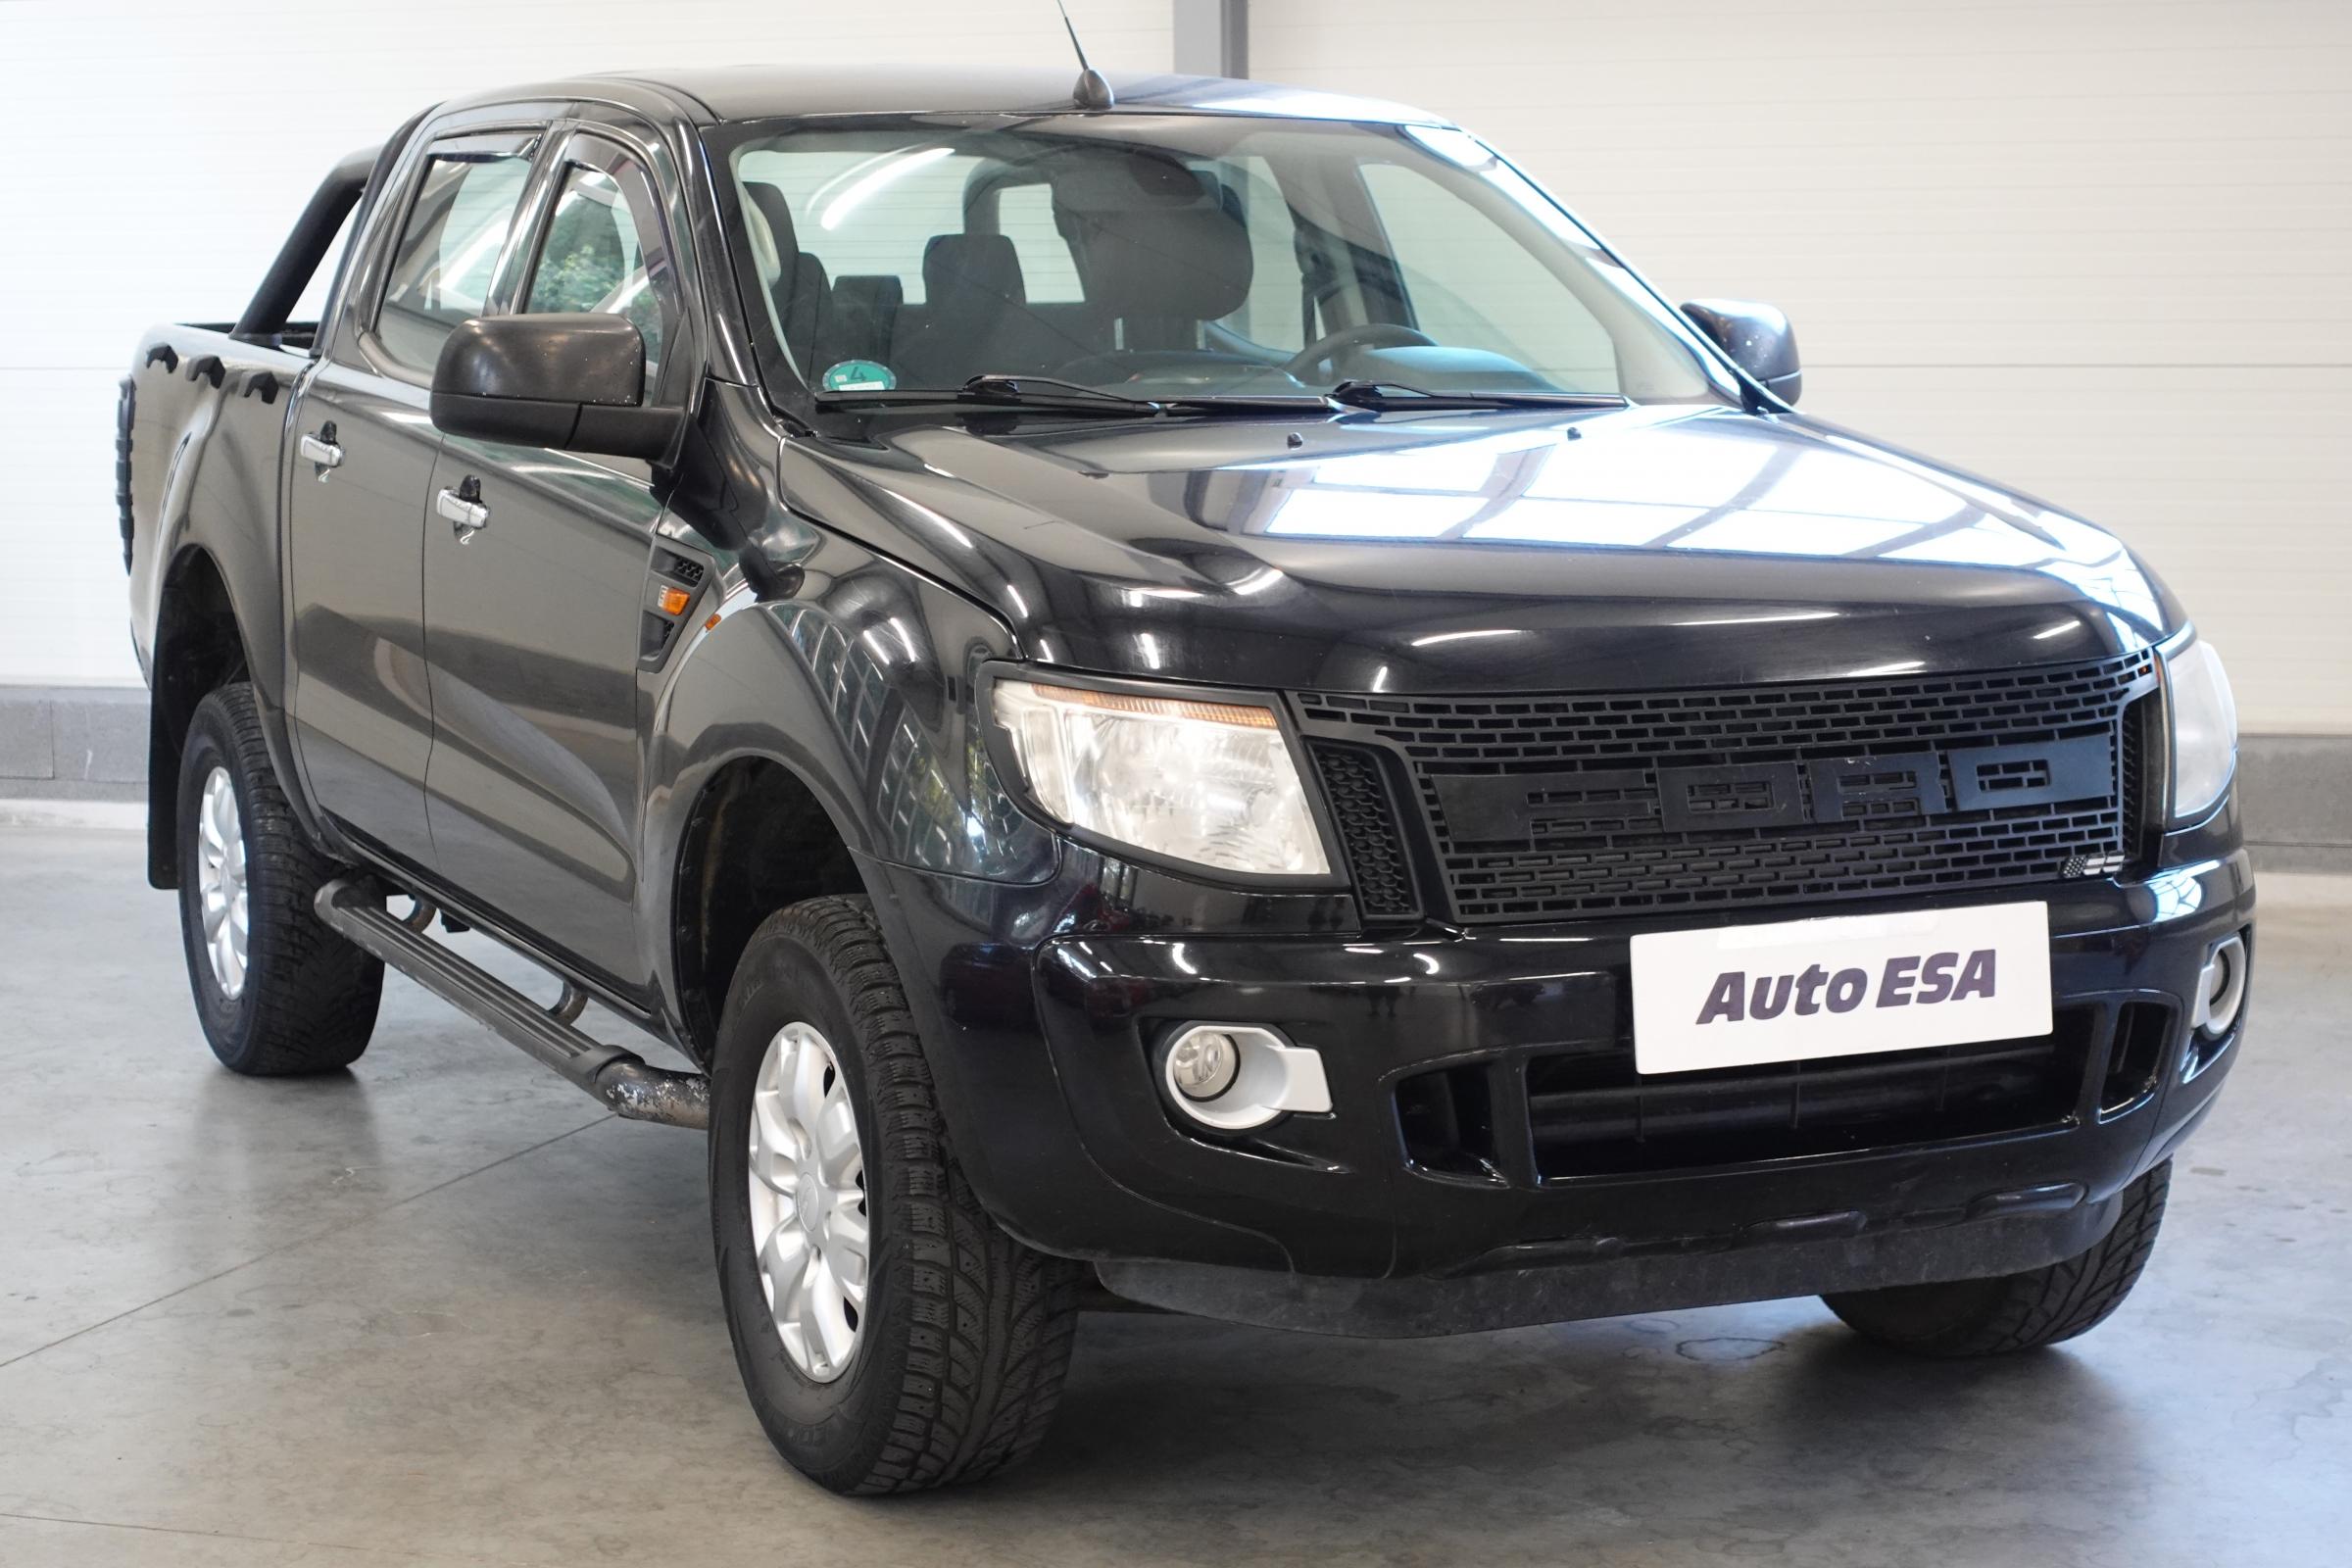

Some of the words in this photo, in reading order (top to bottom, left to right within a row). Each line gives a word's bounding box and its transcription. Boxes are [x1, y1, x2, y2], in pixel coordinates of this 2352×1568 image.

[850, 367, 866, 380] 4
[1695, 963, 1868, 1025] Auto
[1876, 949, 1995, 1008] ESA
